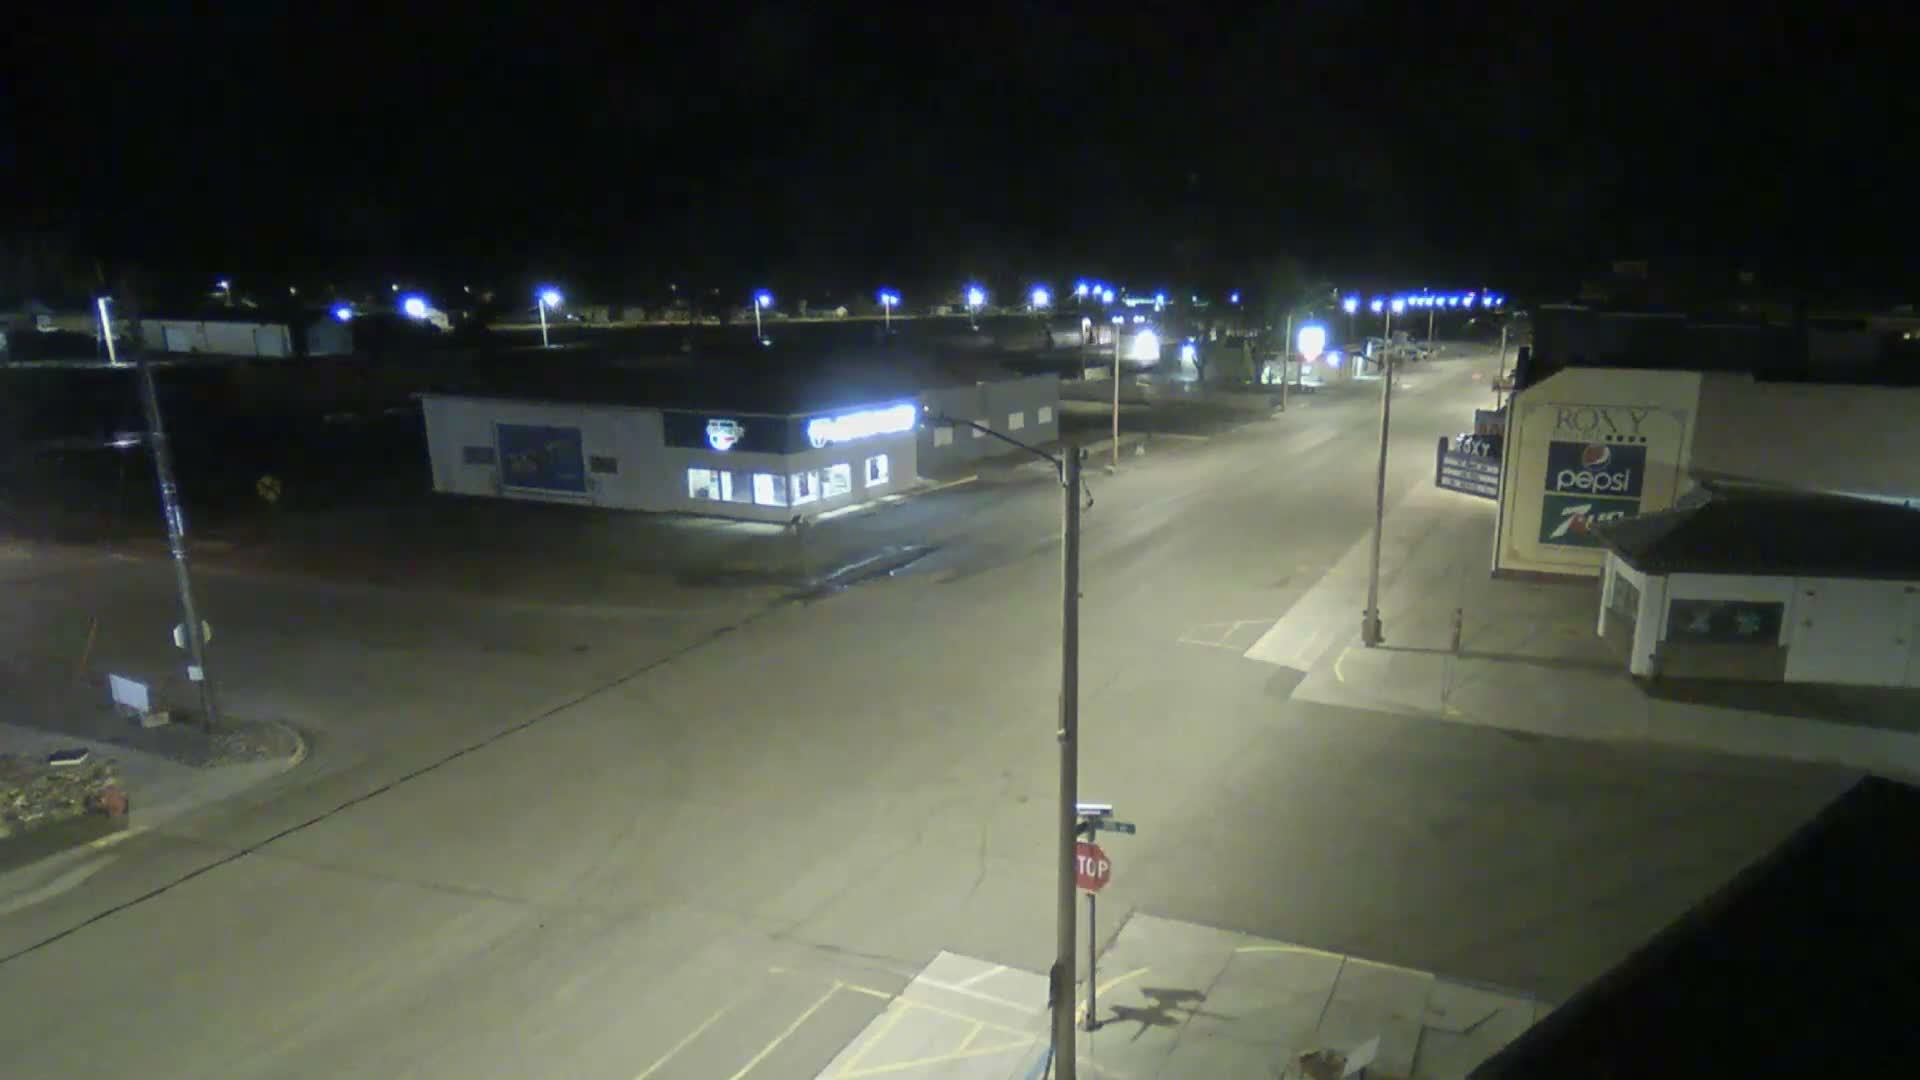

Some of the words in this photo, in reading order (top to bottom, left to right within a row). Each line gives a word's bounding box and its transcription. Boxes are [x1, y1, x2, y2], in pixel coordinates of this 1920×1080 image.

[1555, 408, 1649, 433] ROXY
[1556, 469, 1631, 494] pepsi
[1077, 855, 1109, 879] TOP
